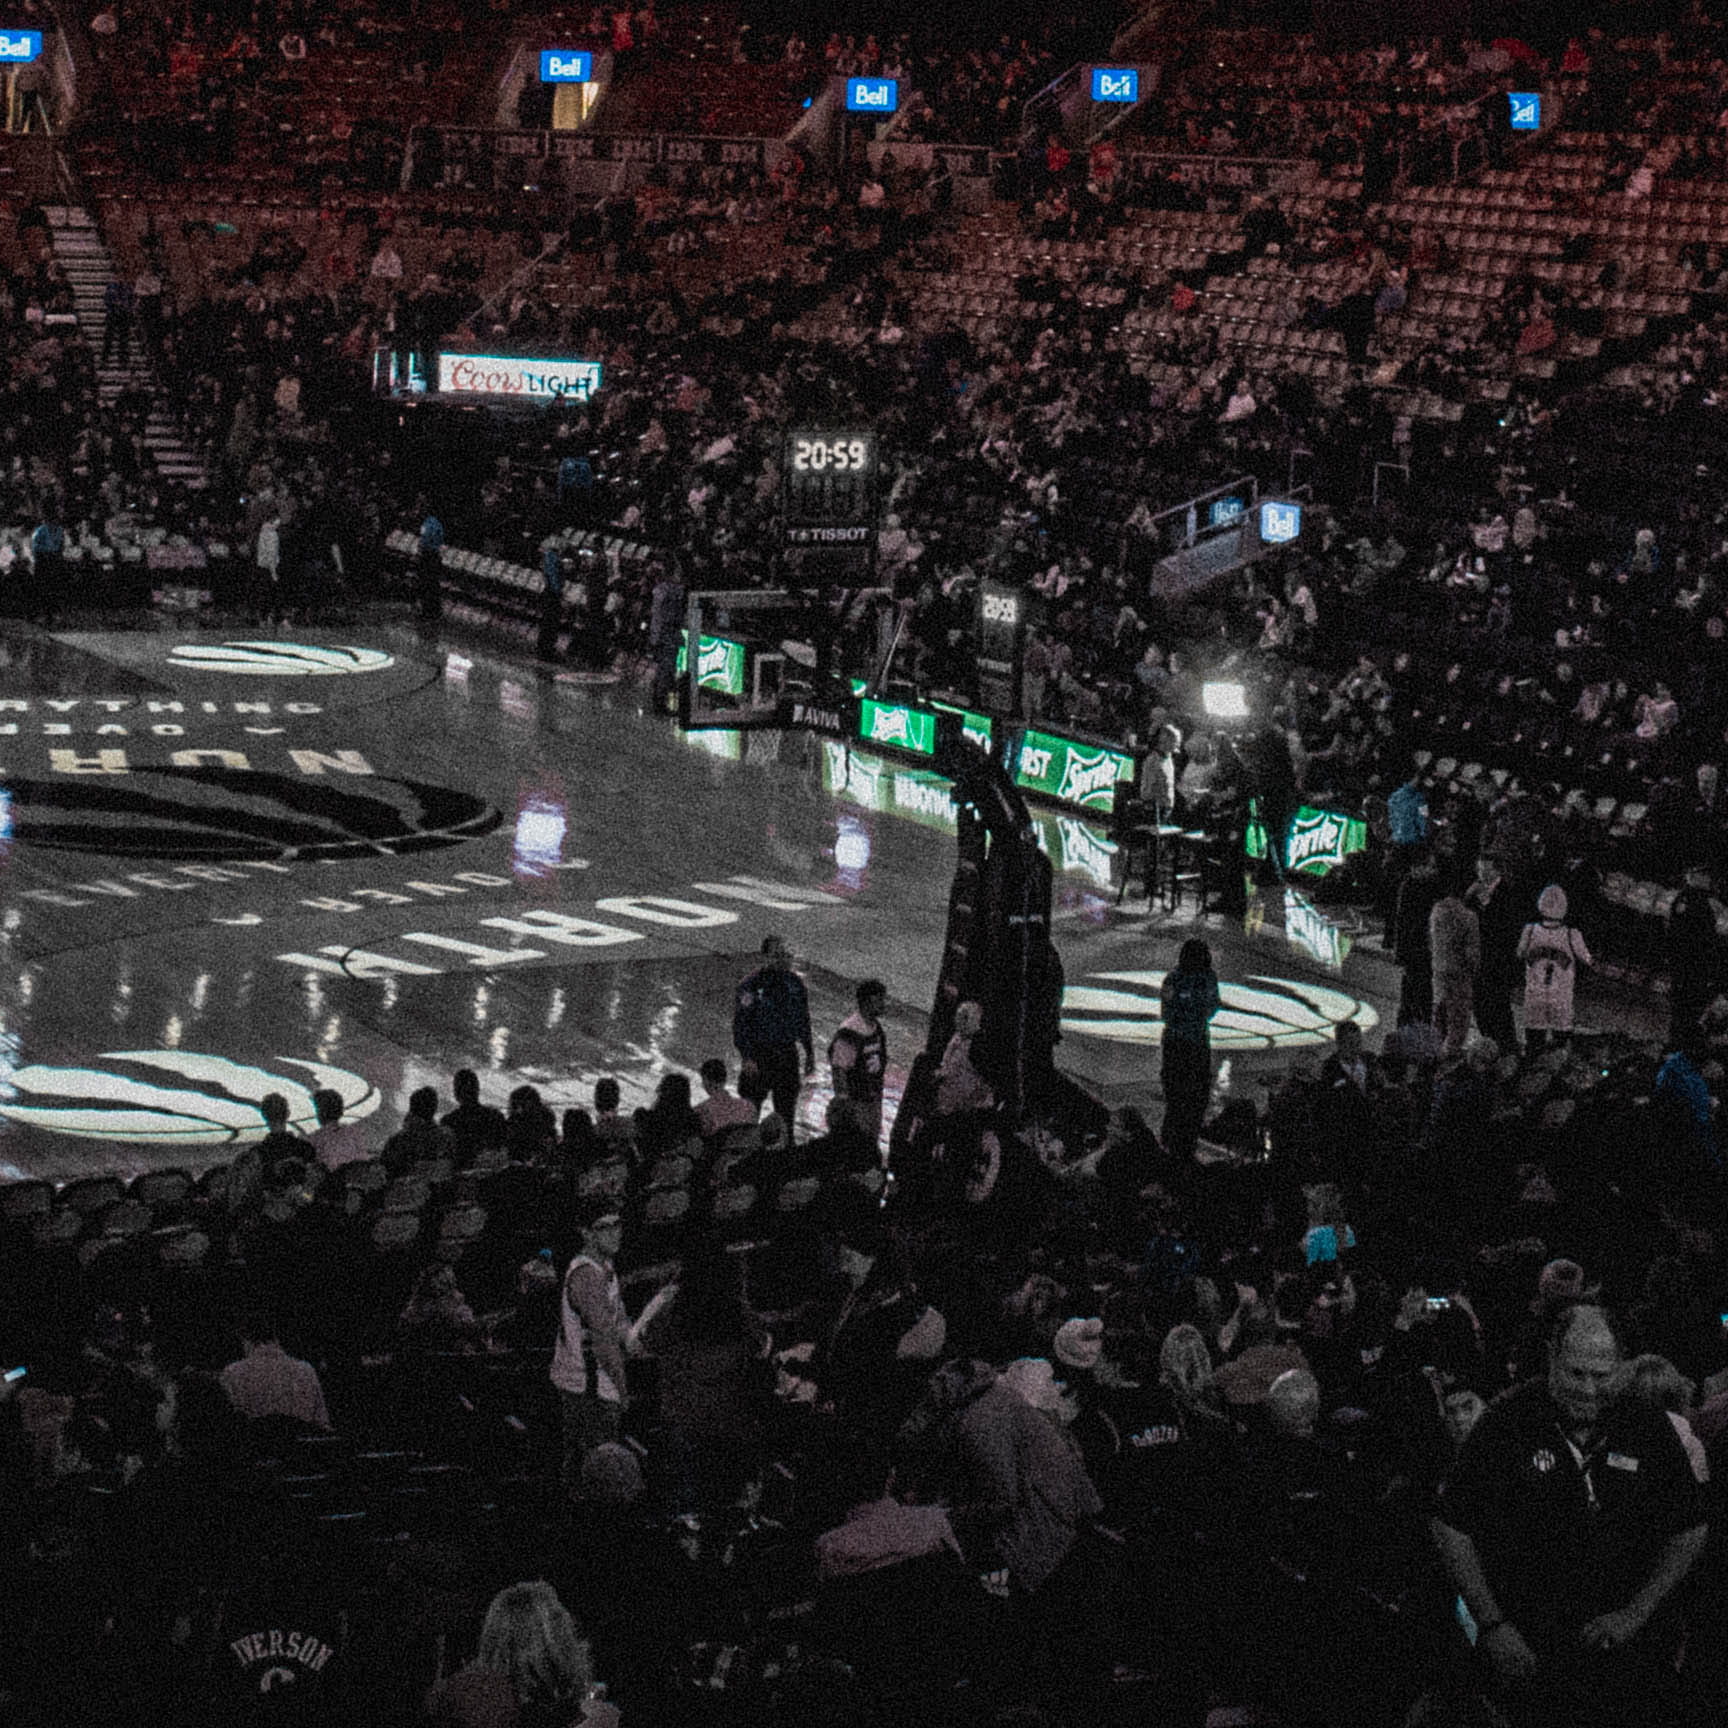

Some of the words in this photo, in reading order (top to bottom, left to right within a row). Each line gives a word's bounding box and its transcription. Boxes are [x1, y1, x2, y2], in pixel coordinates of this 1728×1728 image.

[549, 56, 583, 77] Bell
[855, 85, 888, 106] Bell
[449, 358, 529, 392] Coors
[528, 368, 599, 399] LIGHT
[794, 439, 865, 470] 20:59
[811, 527, 869, 543] TISSOT
[274, 875, 845, 979] NORTH
[229, 1628, 336, 1674] IVERSON
